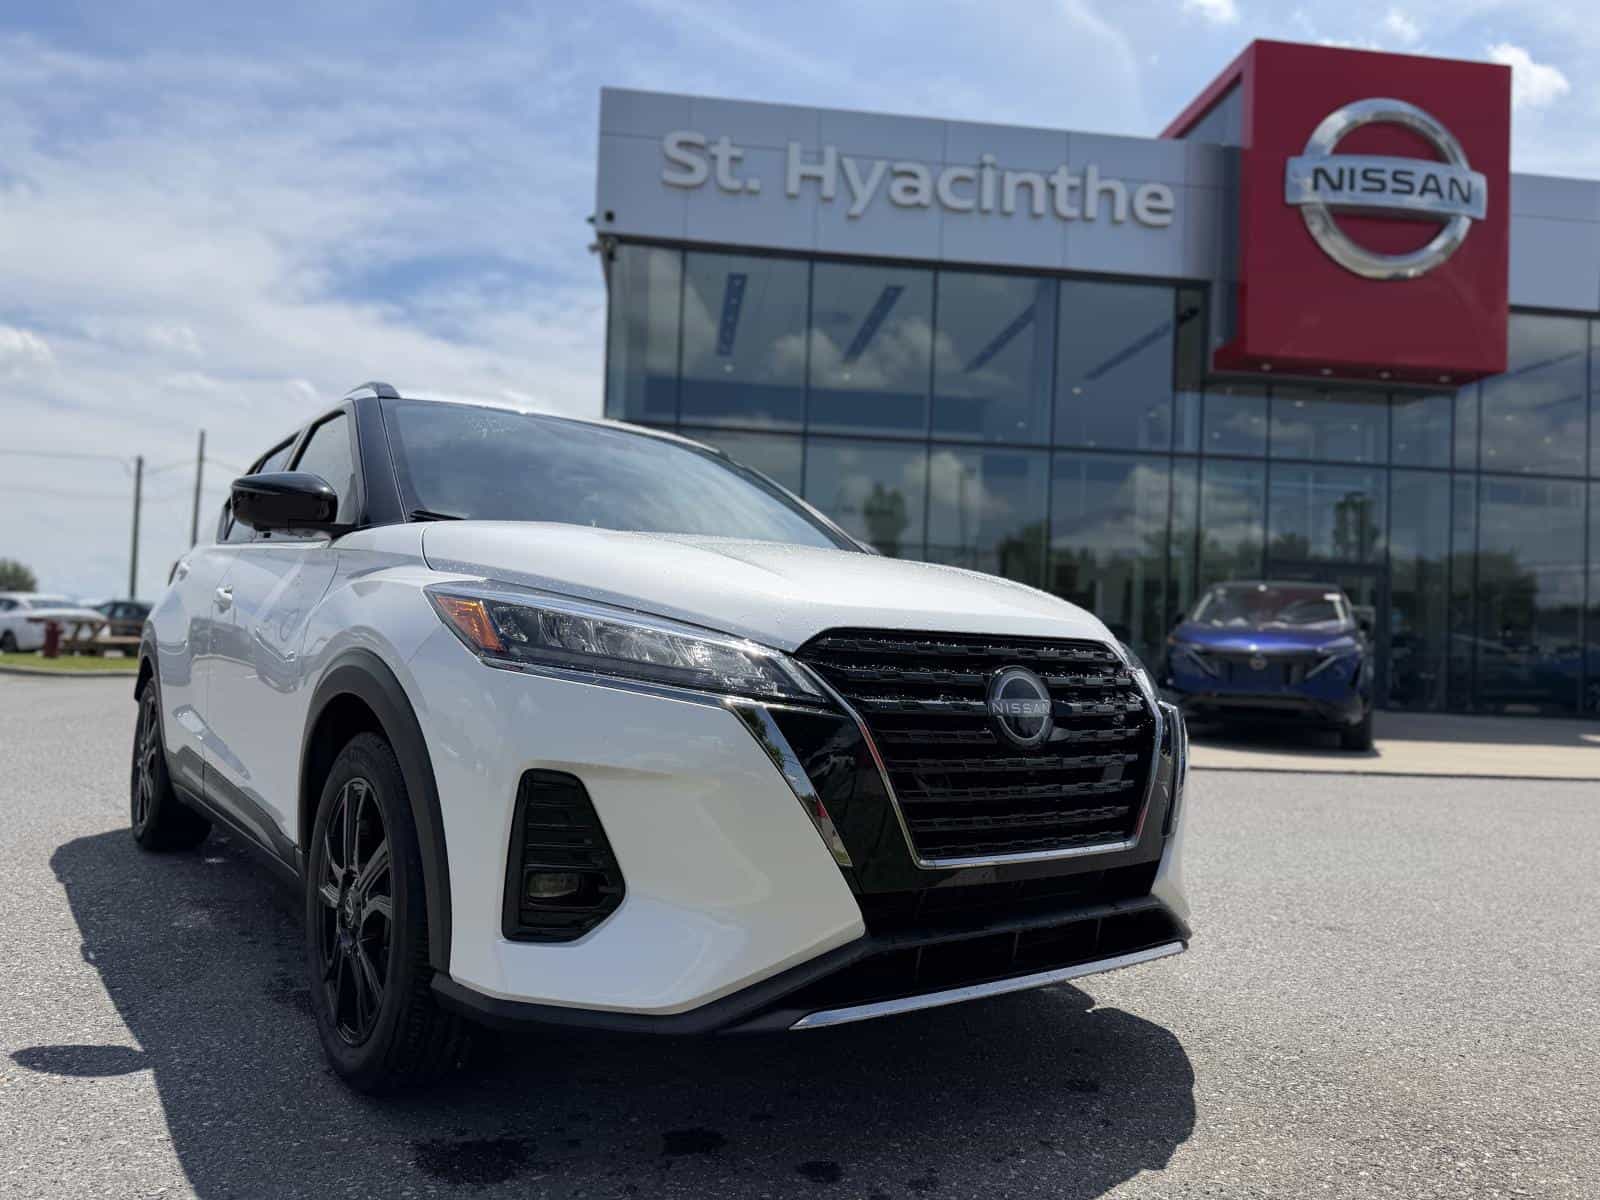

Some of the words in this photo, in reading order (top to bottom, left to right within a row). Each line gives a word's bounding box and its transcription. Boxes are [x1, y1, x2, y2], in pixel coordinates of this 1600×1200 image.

[661, 130, 760, 193] St.
[786, 142, 1176, 227] Hyacinthe
[1312, 166, 1472, 204] NISSAN
[991, 702, 1050, 714] NISSAN
